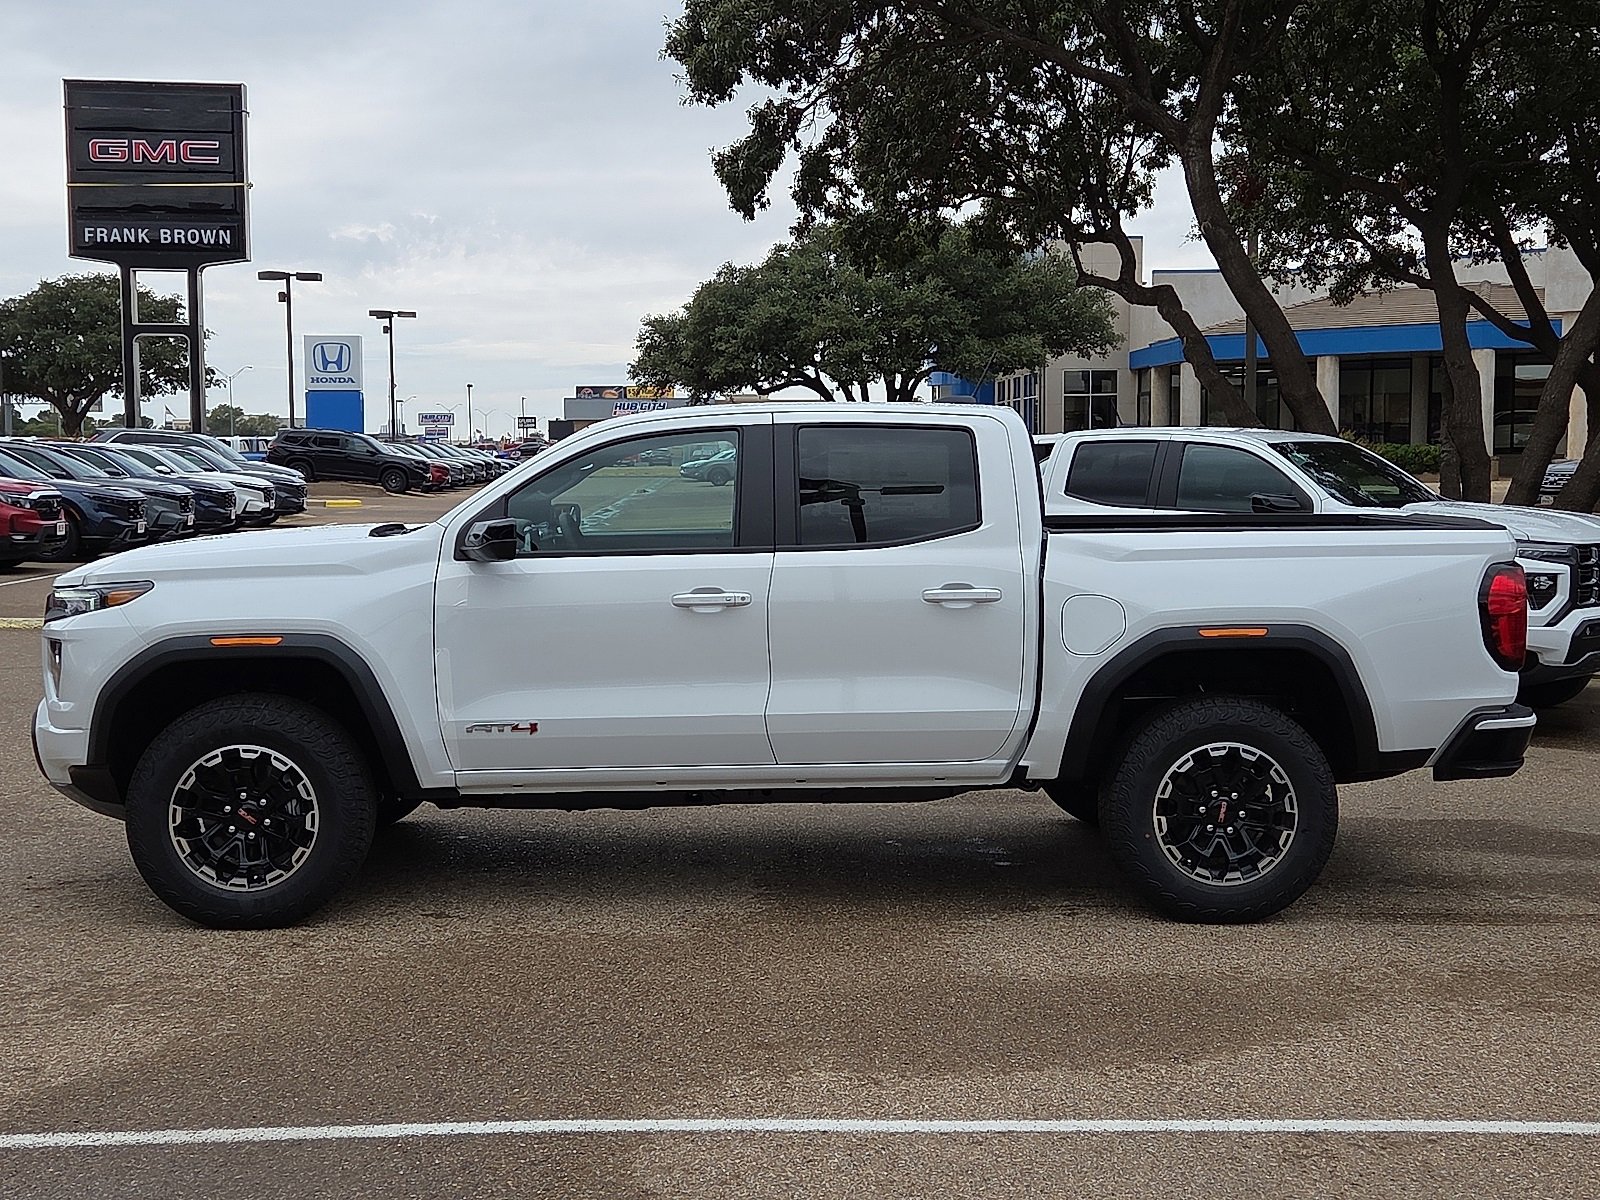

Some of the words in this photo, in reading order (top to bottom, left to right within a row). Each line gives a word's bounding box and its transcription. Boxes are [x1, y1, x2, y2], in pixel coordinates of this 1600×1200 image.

[89, 138, 219, 164] GMC
[84, 227, 150, 243] FRANK
[159, 228, 231, 245] BROWN
[310, 376, 356, 384] HONDA
[613, 401, 639, 411] HUB
[639, 401, 668, 411] CITY
